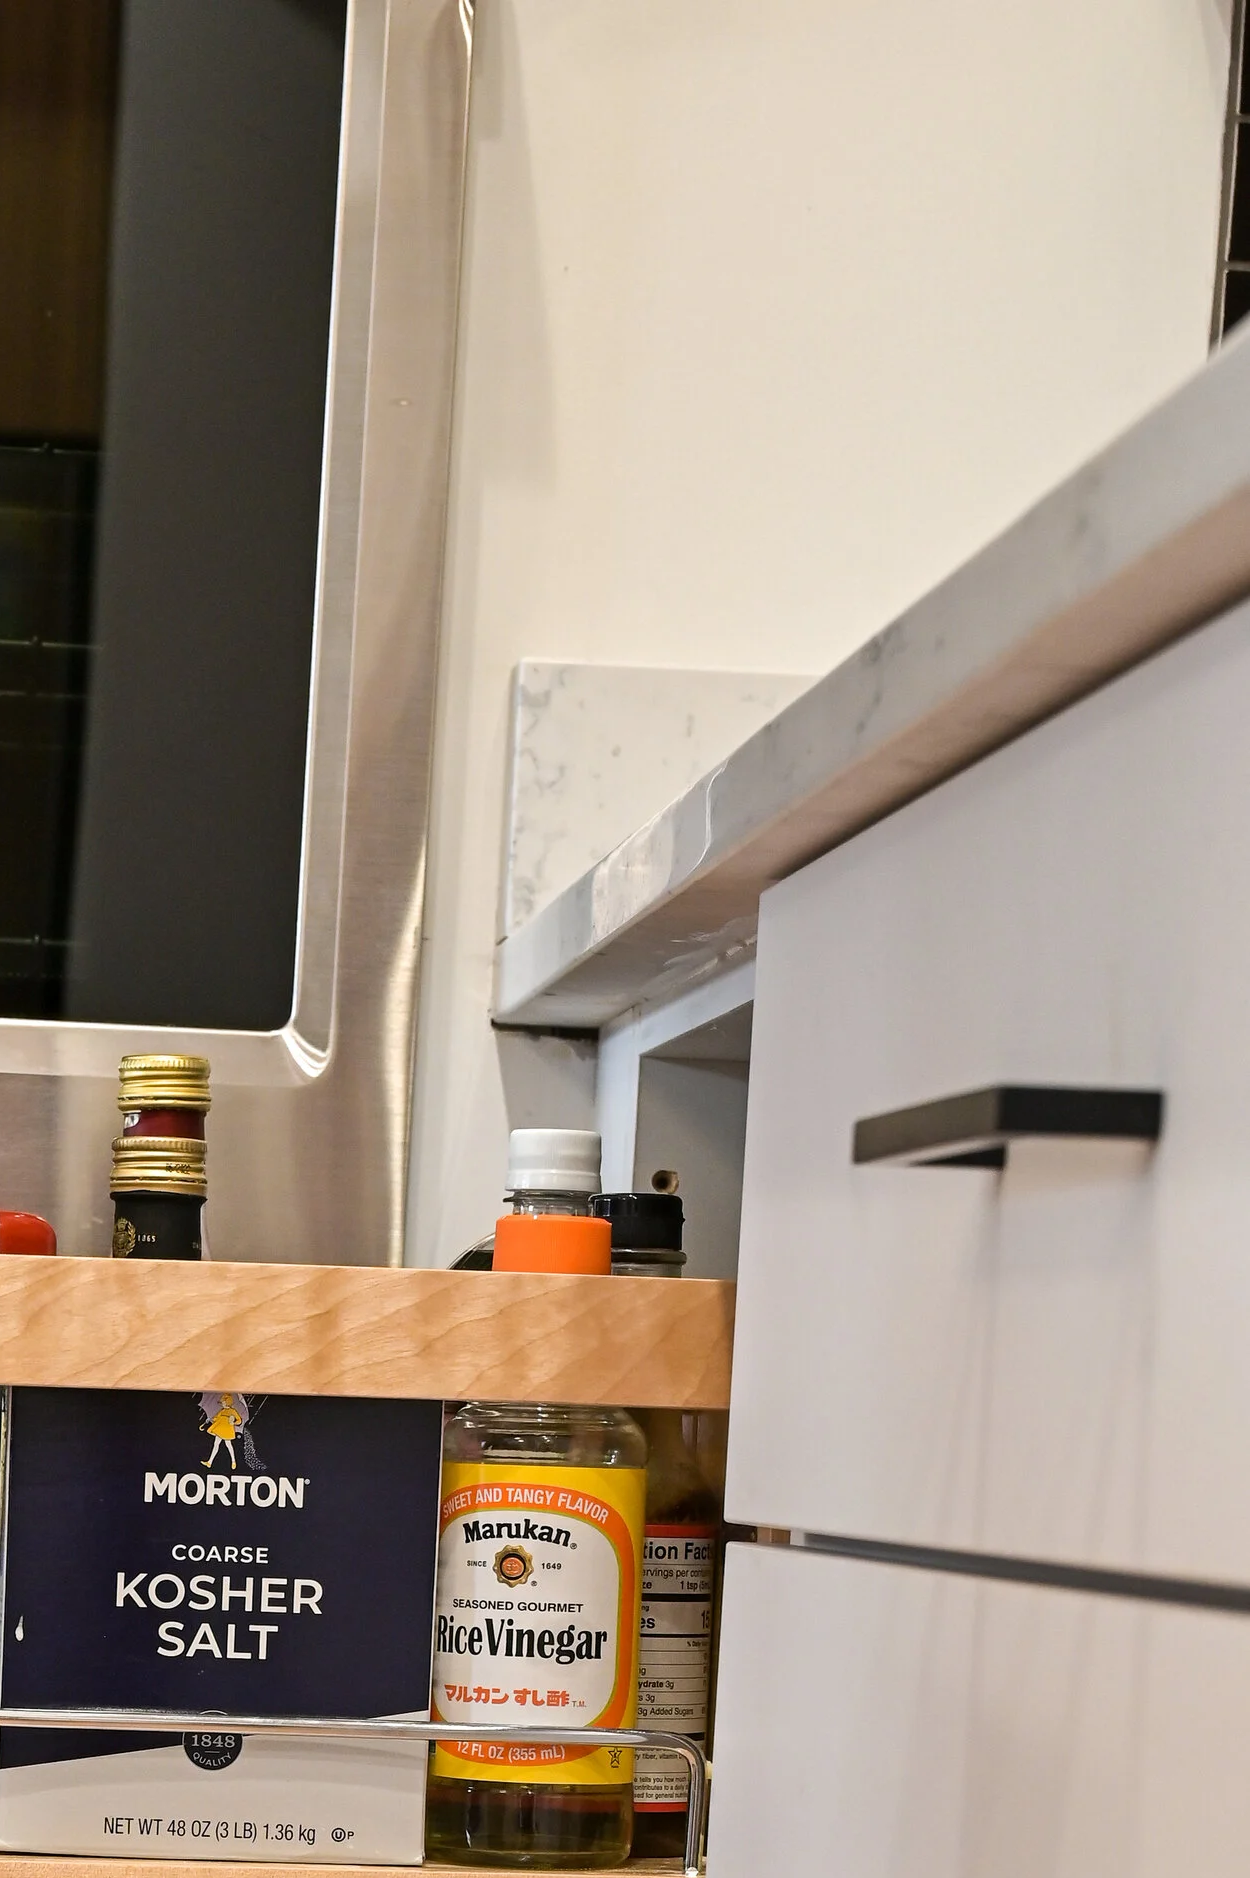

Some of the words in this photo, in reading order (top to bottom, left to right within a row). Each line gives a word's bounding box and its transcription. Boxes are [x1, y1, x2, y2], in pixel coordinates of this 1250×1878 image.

[143, 1471, 306, 1510] MORTON
[442, 1491, 473, 1519] SWEET
[475, 1487, 503, 1504] AND
[505, 1487, 559, 1506] TANGY
[557, 1492, 609, 1524] FLAVOR
[462, 1518, 572, 1548] Marukan
[170, 1543, 270, 1565] COARSE
[466, 1560, 487, 1568] SINCE
[541, 1562, 562, 1570] 1649
[115, 1570, 324, 1616] KOSHER
[452, 1598, 514, 1611] SEASONED
[517, 1601, 584, 1613] GOURMET
[156, 1620, 279, 1661] SALT
[436, 1615, 483, 1656] Rice
[485, 1618, 608, 1665] Vinegar
[444, 1684, 509, 1705] マルカン
[650, 1707, 673, 1716] Added
[191, 1734, 236, 1748] 1848
[192, 1751, 233, 1768] QUALITY
[471, 1742, 485, 1758] FL
[488, 1745, 505, 1761] OZ
[508, 1745, 536, 1764] (355
[540, 1745, 566, 1761] mL)
[103, 1816, 135, 1836] NET
[138, 1818, 163, 1836] WT
[166, 1819, 186, 1837] 48
[191, 1820, 211, 1838] OZ
[214, 1821, 229, 1842] (3
[233, 1822, 258, 1843] LB)
[263, 1823, 294, 1842] 1.36
[298, 1824, 316, 1846] kg
